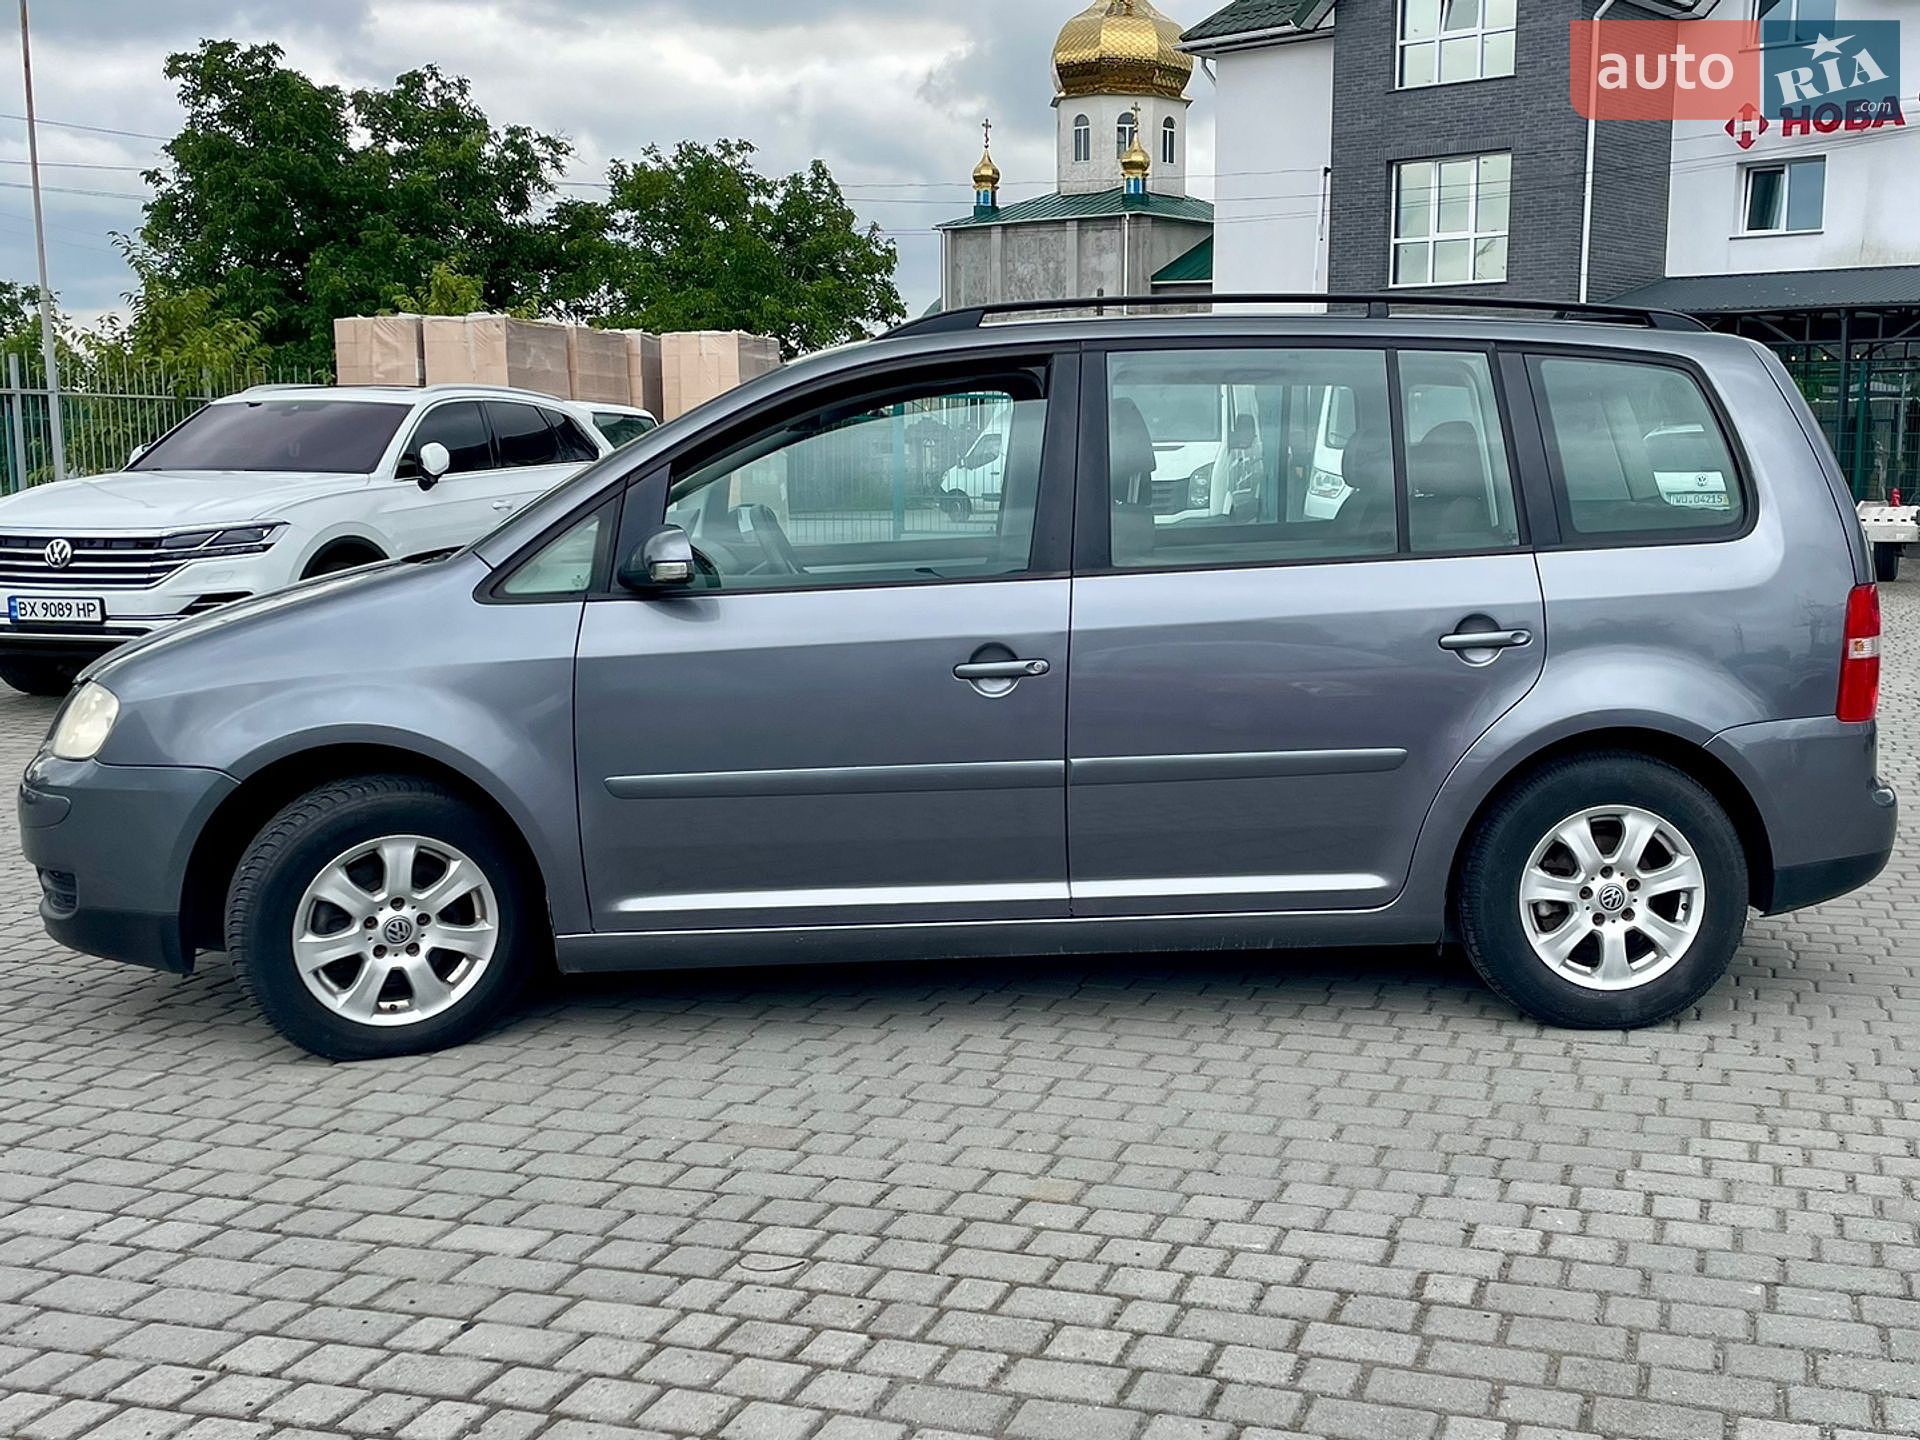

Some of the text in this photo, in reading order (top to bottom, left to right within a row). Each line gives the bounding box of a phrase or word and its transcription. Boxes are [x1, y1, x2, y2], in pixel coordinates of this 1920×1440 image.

[18, 601, 97, 618] BX 9089 HP
